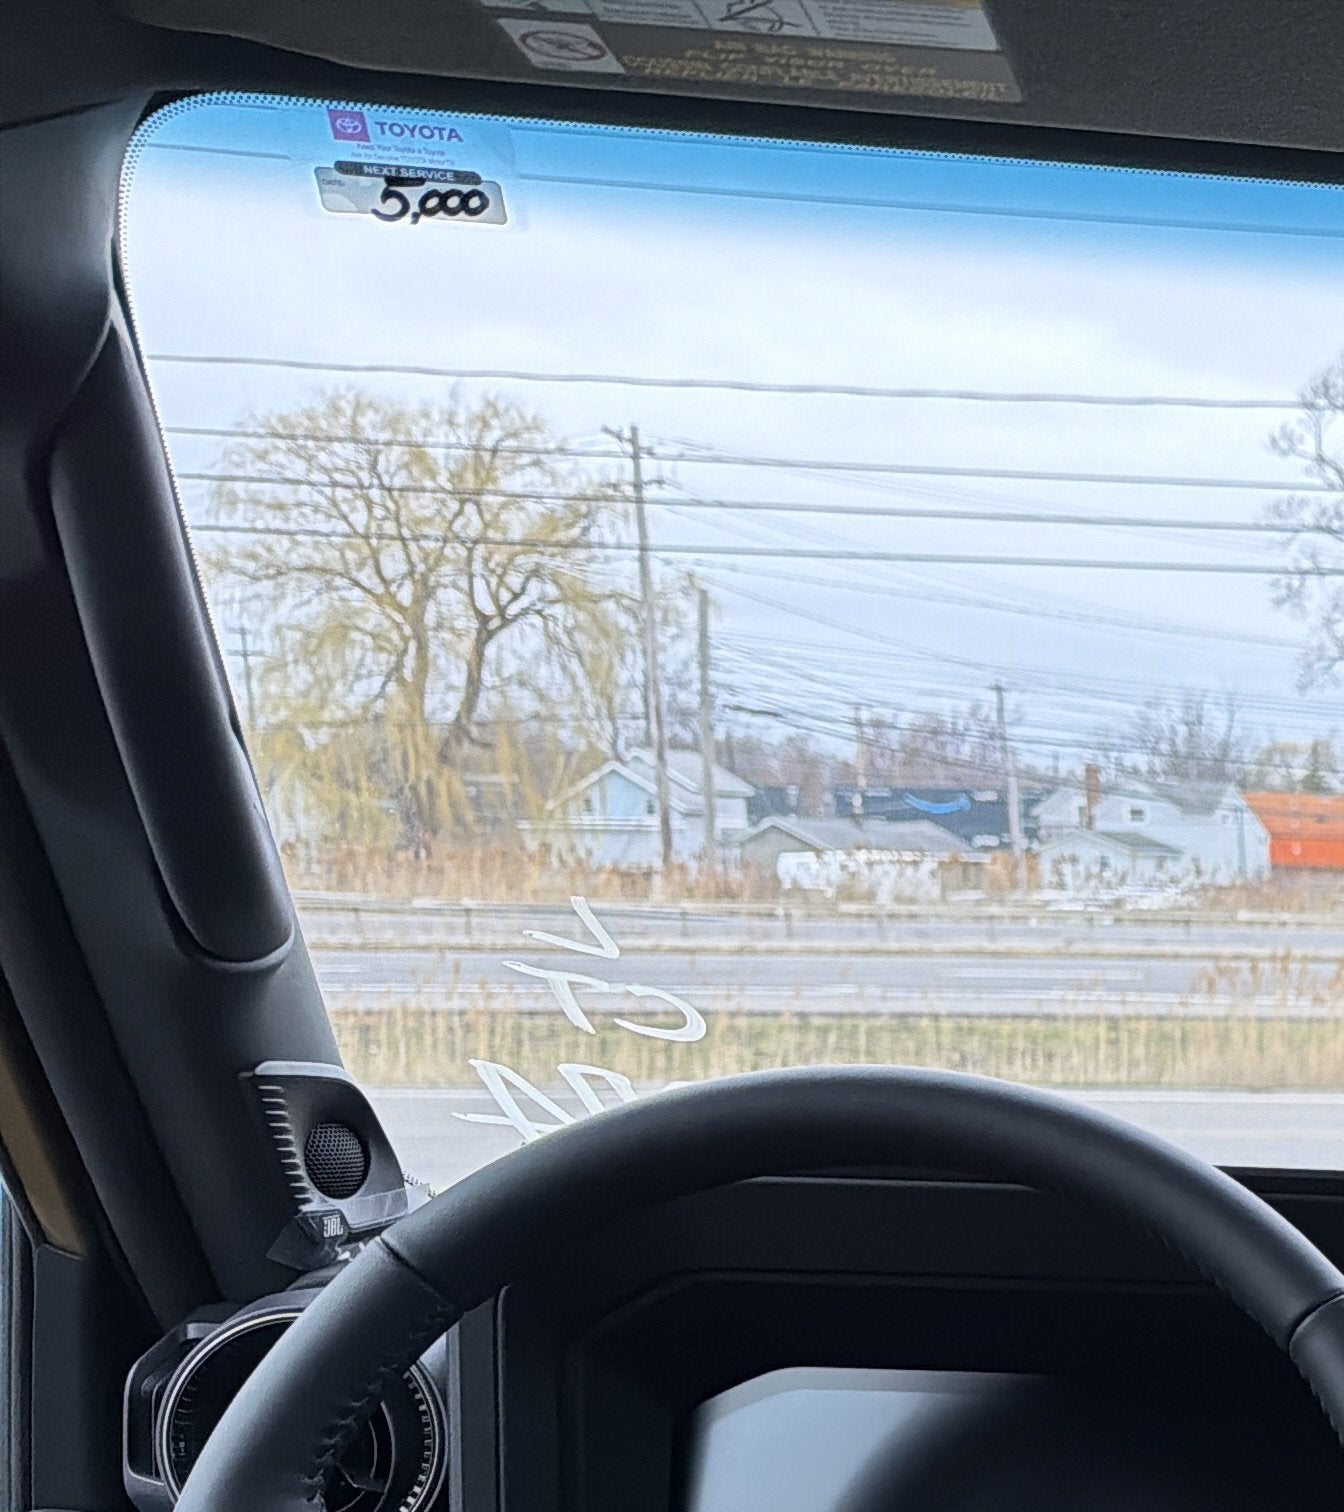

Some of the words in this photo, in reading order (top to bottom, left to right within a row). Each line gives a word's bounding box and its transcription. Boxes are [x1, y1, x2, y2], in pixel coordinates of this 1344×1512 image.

[374, 121, 464, 143] TOYOTA
[363, 165, 397, 178] NEXT
[400, 168, 455, 181] SERVICE
[371, 176, 490, 225] 5,000
[322, 1214, 344, 1238] JBL
